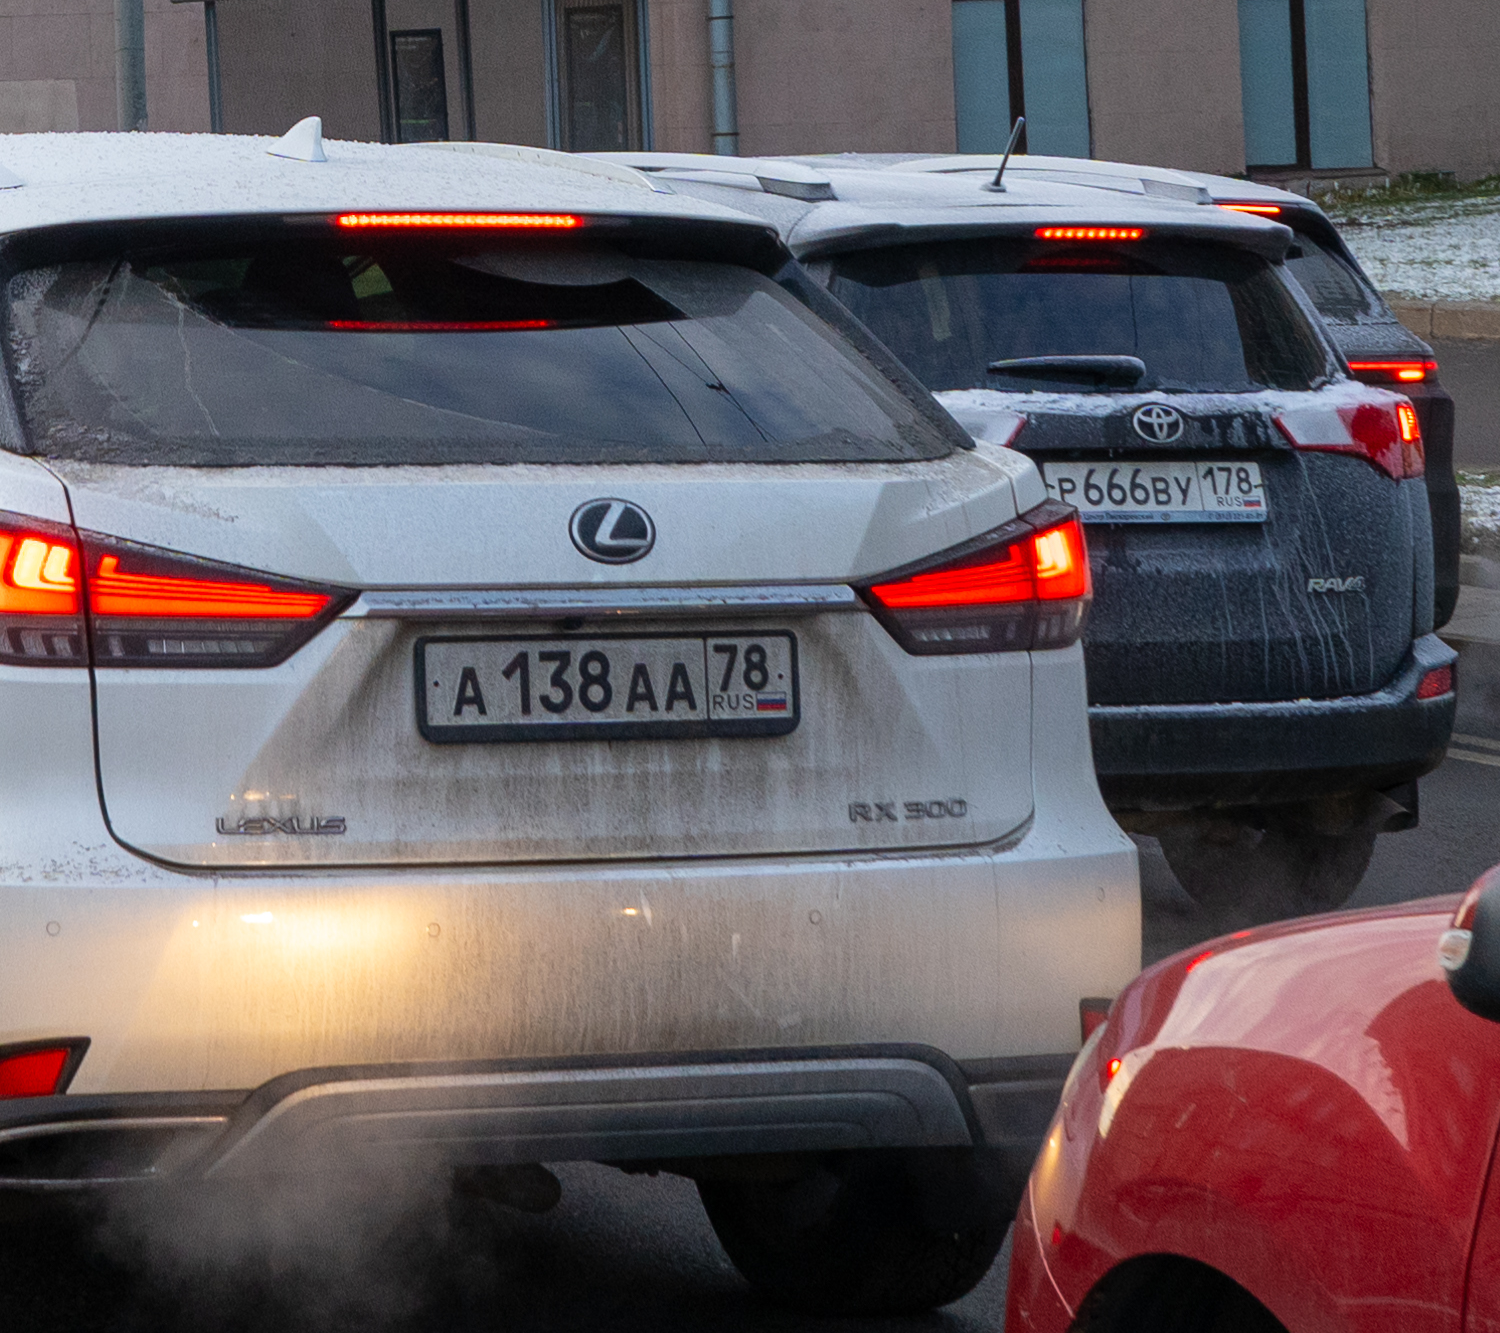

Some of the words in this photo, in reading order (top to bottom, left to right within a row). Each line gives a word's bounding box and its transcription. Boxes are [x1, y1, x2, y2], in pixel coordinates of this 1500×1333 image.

[1202, 466, 1253, 495] 178
[1216, 495, 1243, 508] RUS
[1307, 576, 1367, 593] RAV4
[713, 643, 770, 692] 78
[712, 694, 754, 711] RUS
[848, 800, 898, 823] RX
[903, 798, 968, 820] 300
[215, 816, 348, 835] LEXUS
